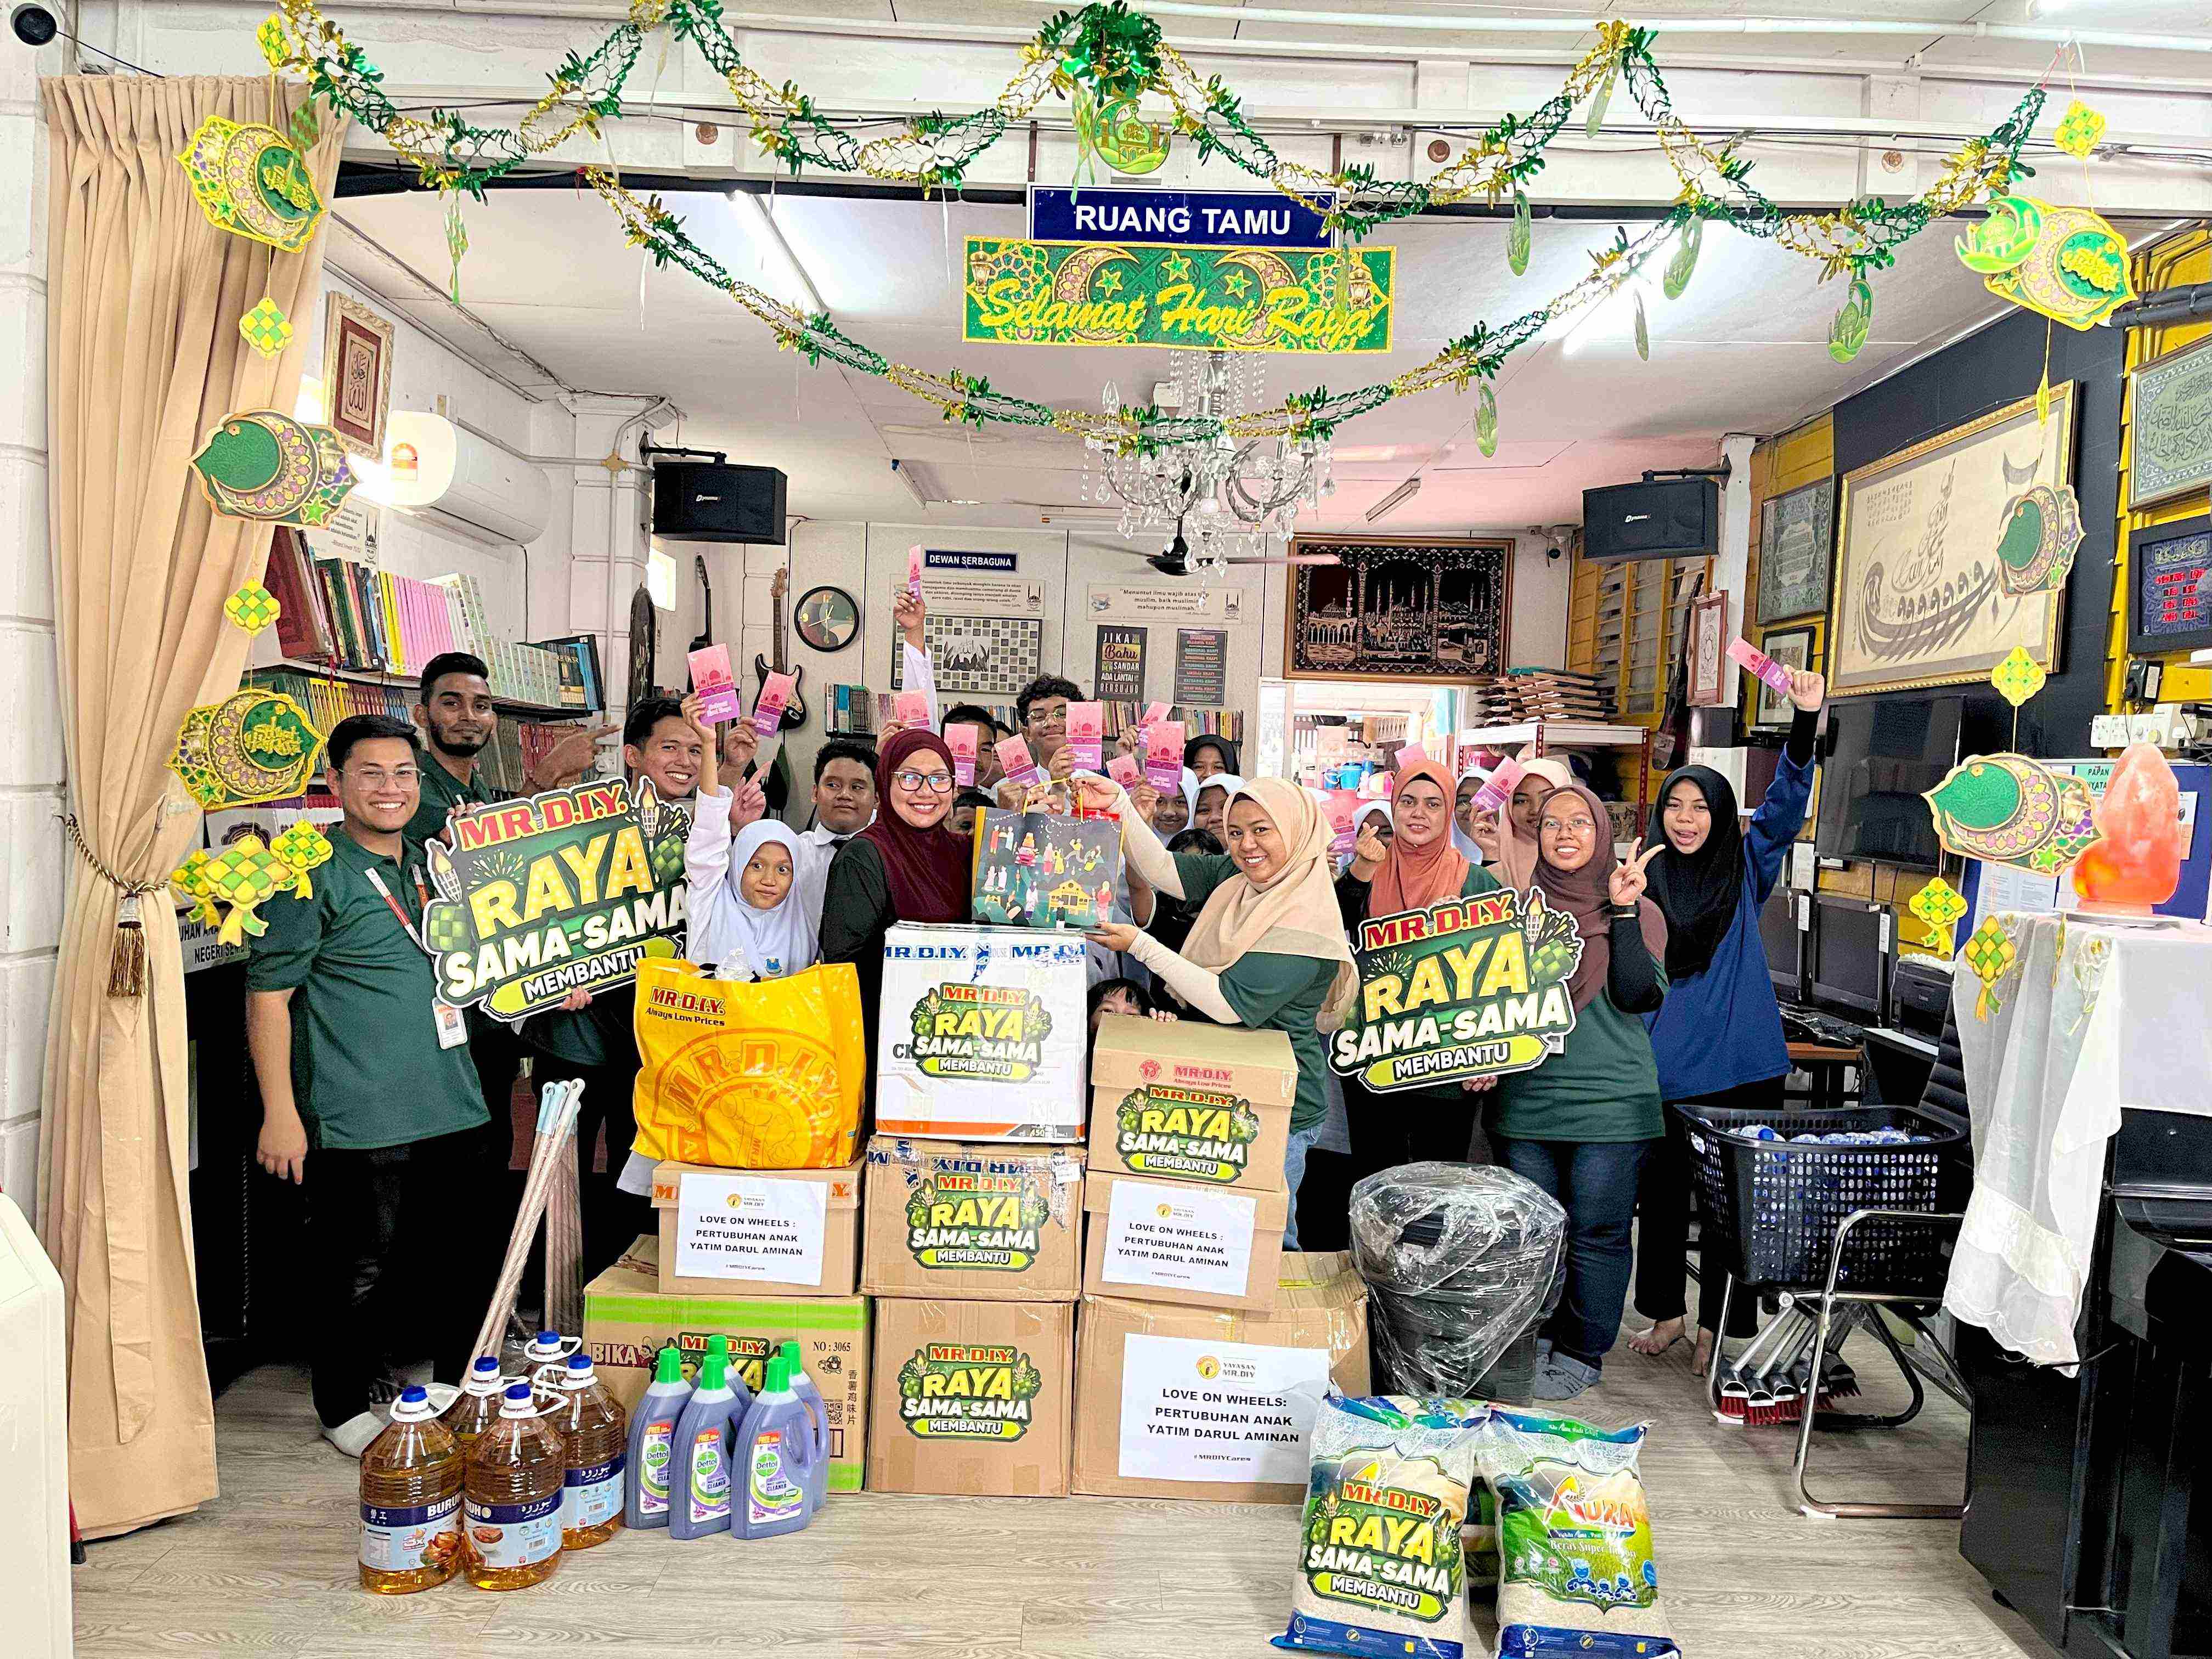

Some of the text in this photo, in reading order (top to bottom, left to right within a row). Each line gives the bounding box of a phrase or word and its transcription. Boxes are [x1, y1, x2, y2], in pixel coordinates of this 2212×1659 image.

[1075, 205, 1291, 235] RUANG TAMU
[980, 278, 1374, 352] Selamat Hari Raya
[929, 555, 1012, 567] DEWAN SERBAGUNA
[1103, 632, 1130, 644] JIKA
[1105, 645, 1138, 659] Bahu
[1101, 673, 1113, 681] ADA
[1114, 673, 1134, 682] LANTAI
[1100, 683, 1139, 694] BERSUJUD
[2088, 768, 2109, 776] PAPAN
[469, 825, 653, 940] RAYA
[445, 884, 687, 998] SAMA-SAMA
[194, 943, 224, 964] NEGERI
[524, 947, 645, 1002] MEMBANTU
[1363, 930, 1528, 1023] RAYA
[646, 1007, 725, 1026] Always Low Prices
[934, 1009, 1024, 1042] RAYA
[1335, 986, 1568, 1068] SAMA-SAMA
[915, 1035, 1038, 1062] SAMA-SAMA
[939, 1058, 1012, 1076] MEMBANTU
[1395, 1043, 1509, 1079] MEMBANTU
[1141, 1109, 1232, 1142] RAYA
[1120, 1132, 1244, 1164] SAMA-SAMA
[1144, 1154, 1218, 1175] MEMBANTU
[700, 1216, 726, 1224] LOVE
[748, 1219, 790, 1228] WHEELS
[930, 1196, 1020, 1230] RAYA
[696, 1229, 798, 1243] PERTUBUHAN ANAK
[911, 1228, 1036, 1250] SAMA-SAMA
[1129, 1222, 1155, 1233] LOVE
[1159, 1226, 1173, 1234] ON
[1177, 1228, 1218, 1240] WHEELS
[690, 1243, 803, 1256] YATIM DARUL AMINAN
[1125, 1236, 1224, 1255] PERTUBUHAN ANAK
[936, 1250, 1011, 1265] MEMBANTU
[1118, 1248, 1228, 1268] YATIM DARUL AMINAN
[591, 1342, 639, 1365] BIKA
[812, 1341, 826, 1352] NO
[833, 1341, 851, 1353] 3065
[1223, 1362, 1256, 1371] YAYASAN
[922, 1367, 1013, 1401] RAYA
[1163, 1388, 1288, 1407] LOVE ON WHEELS:
[904, 1397, 1029, 1420] SAMA-SAMA
[1155, 1407, 1293, 1427] PERTUBUHAN ANAK
[929, 1420, 1003, 1435] MEMBANTU
[1147, 1424, 1299, 1443] YATIM DARUL AMINAN
[646, 1451, 669, 1459] Dettol
[697, 1458, 718, 1468] Dettol
[1194, 1453, 1251, 1462] #MRDIYCares
[756, 1461, 778, 1470] Dettol
[707, 1479, 726, 1489] CLEANER
[766, 1483, 787, 1492] CLEANER
[427, 1491, 462, 1517] BURU
[1329, 1515, 1435, 1566] RAYA
[1550, 1539, 1577, 1550] Beras
[1579, 1541, 1604, 1554] Super
[1307, 1544, 1450, 1596] SAMA-SAMA
[1331, 1577, 1420, 1609] MEMBANTU
